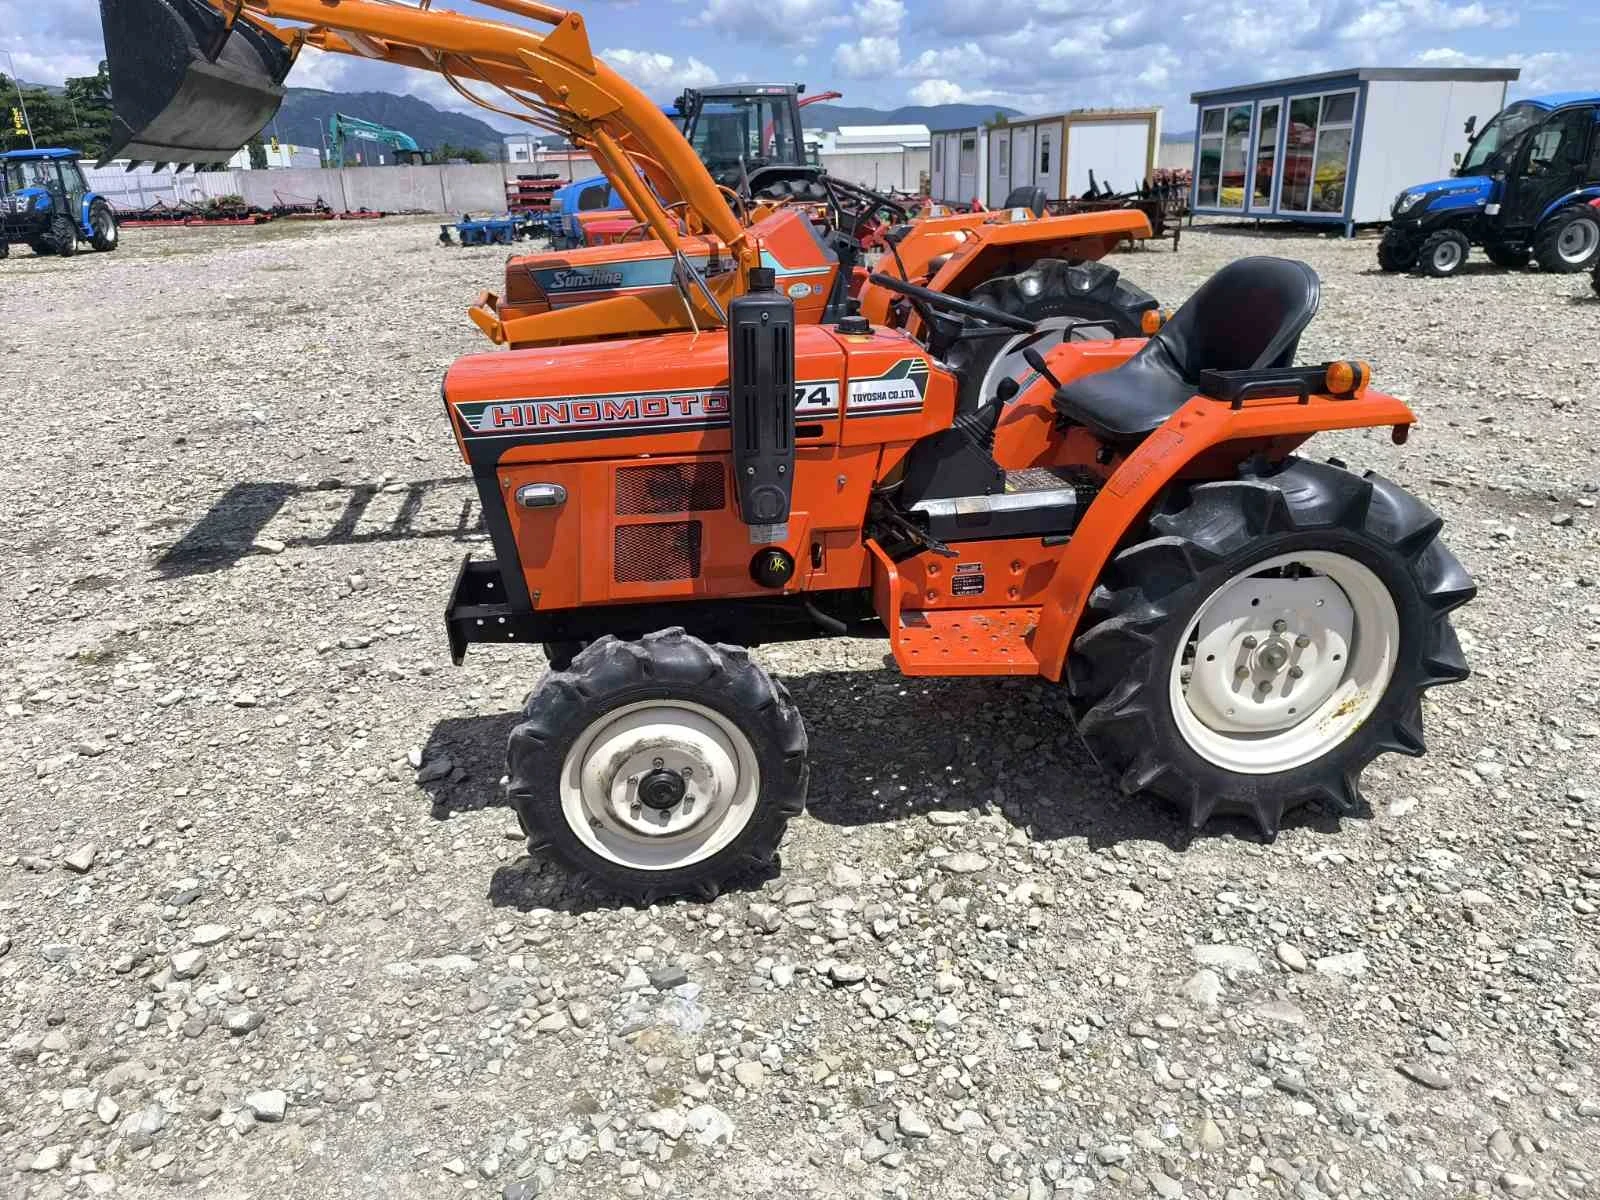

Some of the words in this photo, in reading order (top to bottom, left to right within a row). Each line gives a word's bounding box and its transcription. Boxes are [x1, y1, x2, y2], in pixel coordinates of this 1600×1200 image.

[550, 268, 623, 289] Sunshine
[852, 391, 887, 403] TOYOSHA
[492, 394, 729, 427] HINOMOTO
